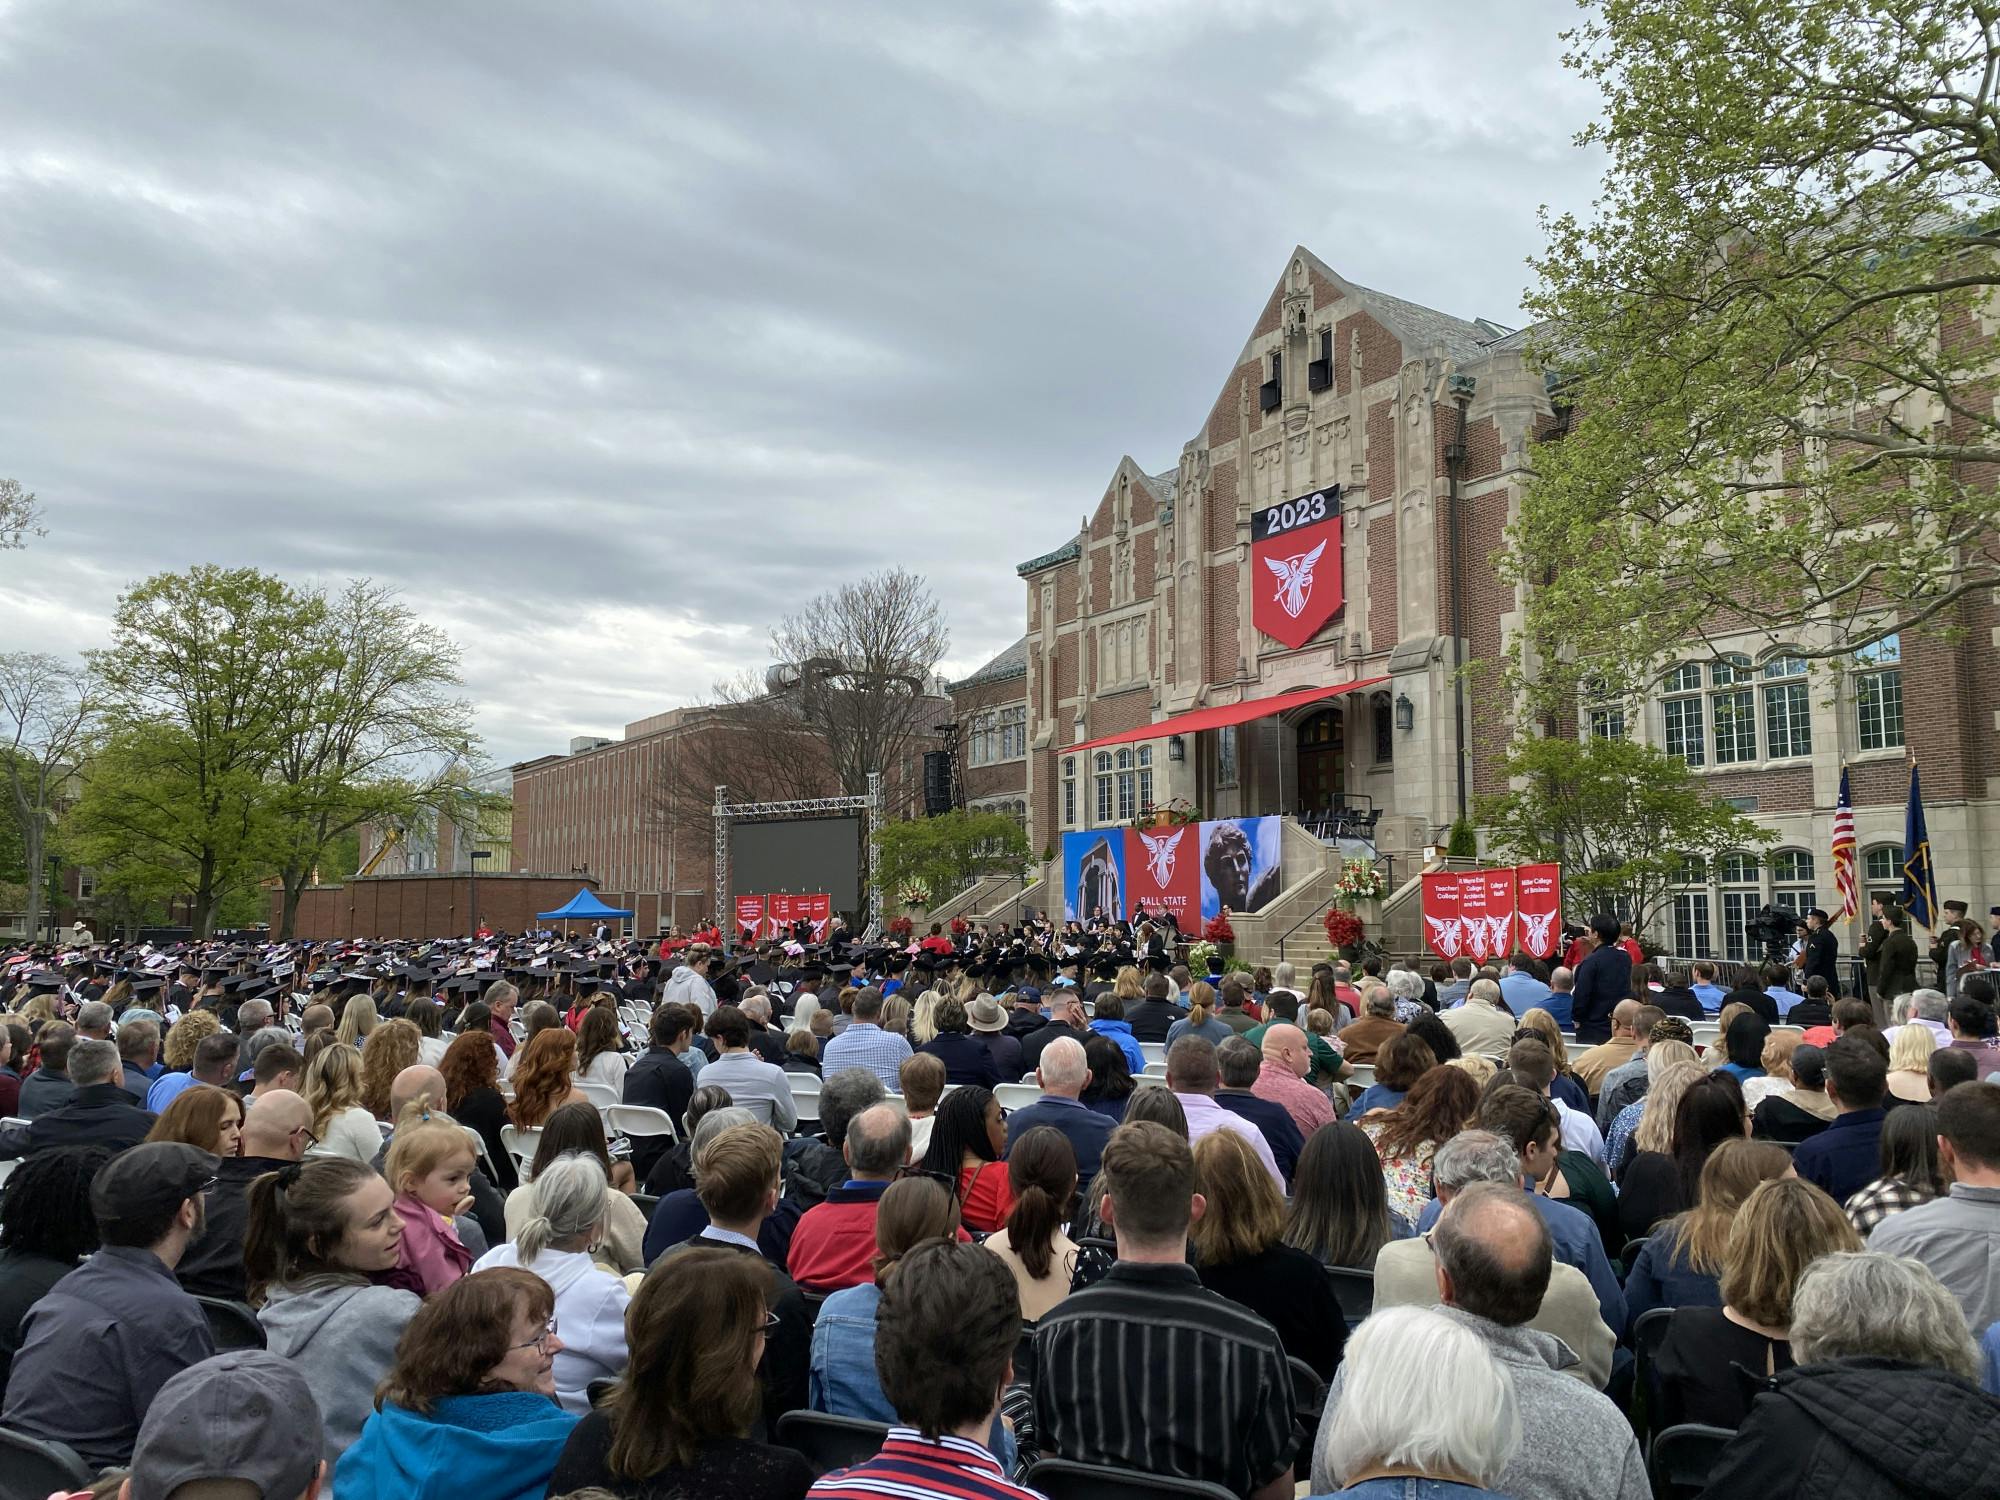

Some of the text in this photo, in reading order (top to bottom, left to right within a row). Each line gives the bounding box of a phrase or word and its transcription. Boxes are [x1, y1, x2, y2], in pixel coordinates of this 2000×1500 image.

[1267, 493, 1326, 535] 2023
[1141, 896, 1187, 906] BALL STATE
[1143, 908, 1184, 917] UNIVSITY
